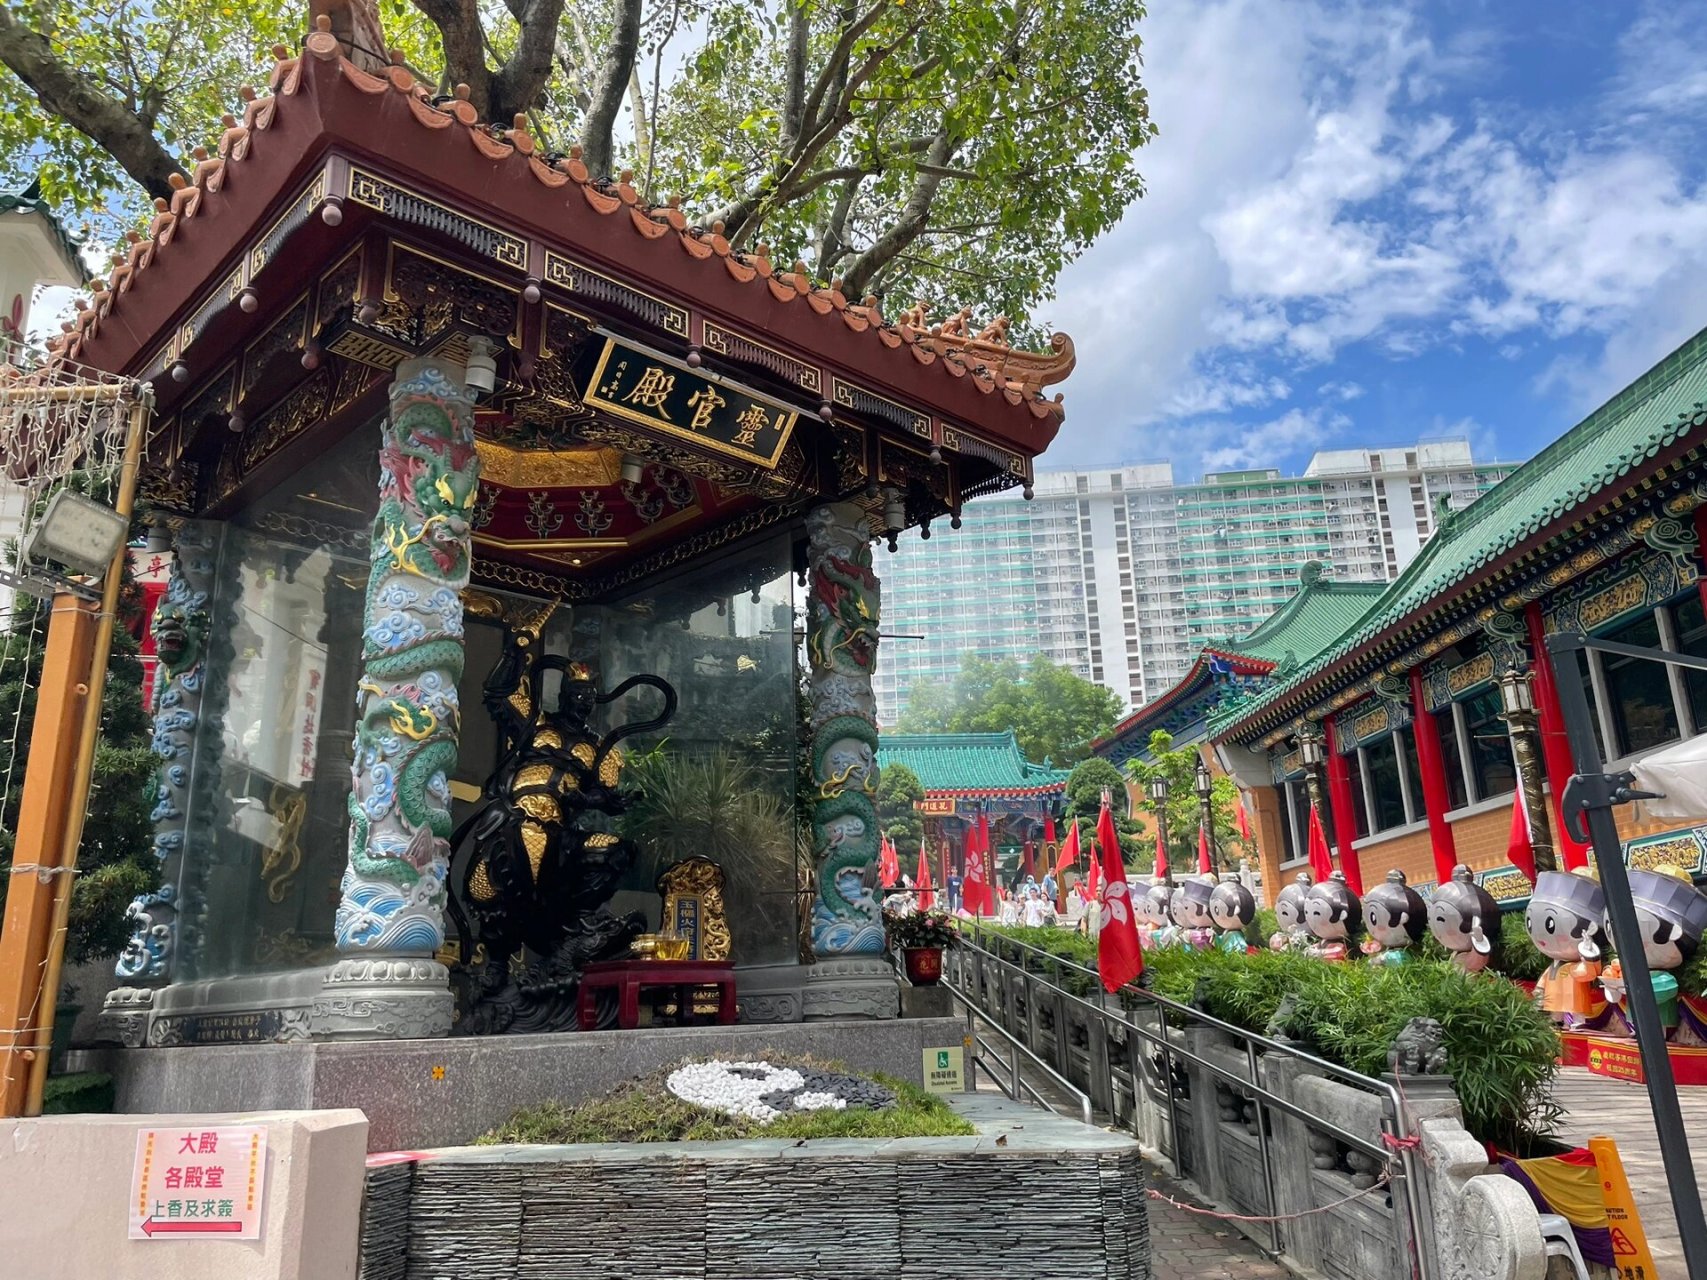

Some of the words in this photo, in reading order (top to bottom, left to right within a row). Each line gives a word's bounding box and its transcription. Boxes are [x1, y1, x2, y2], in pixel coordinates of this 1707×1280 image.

[178, 1132, 219, 1154] 大殿
[164, 1165, 225, 1190] 各殿堂
